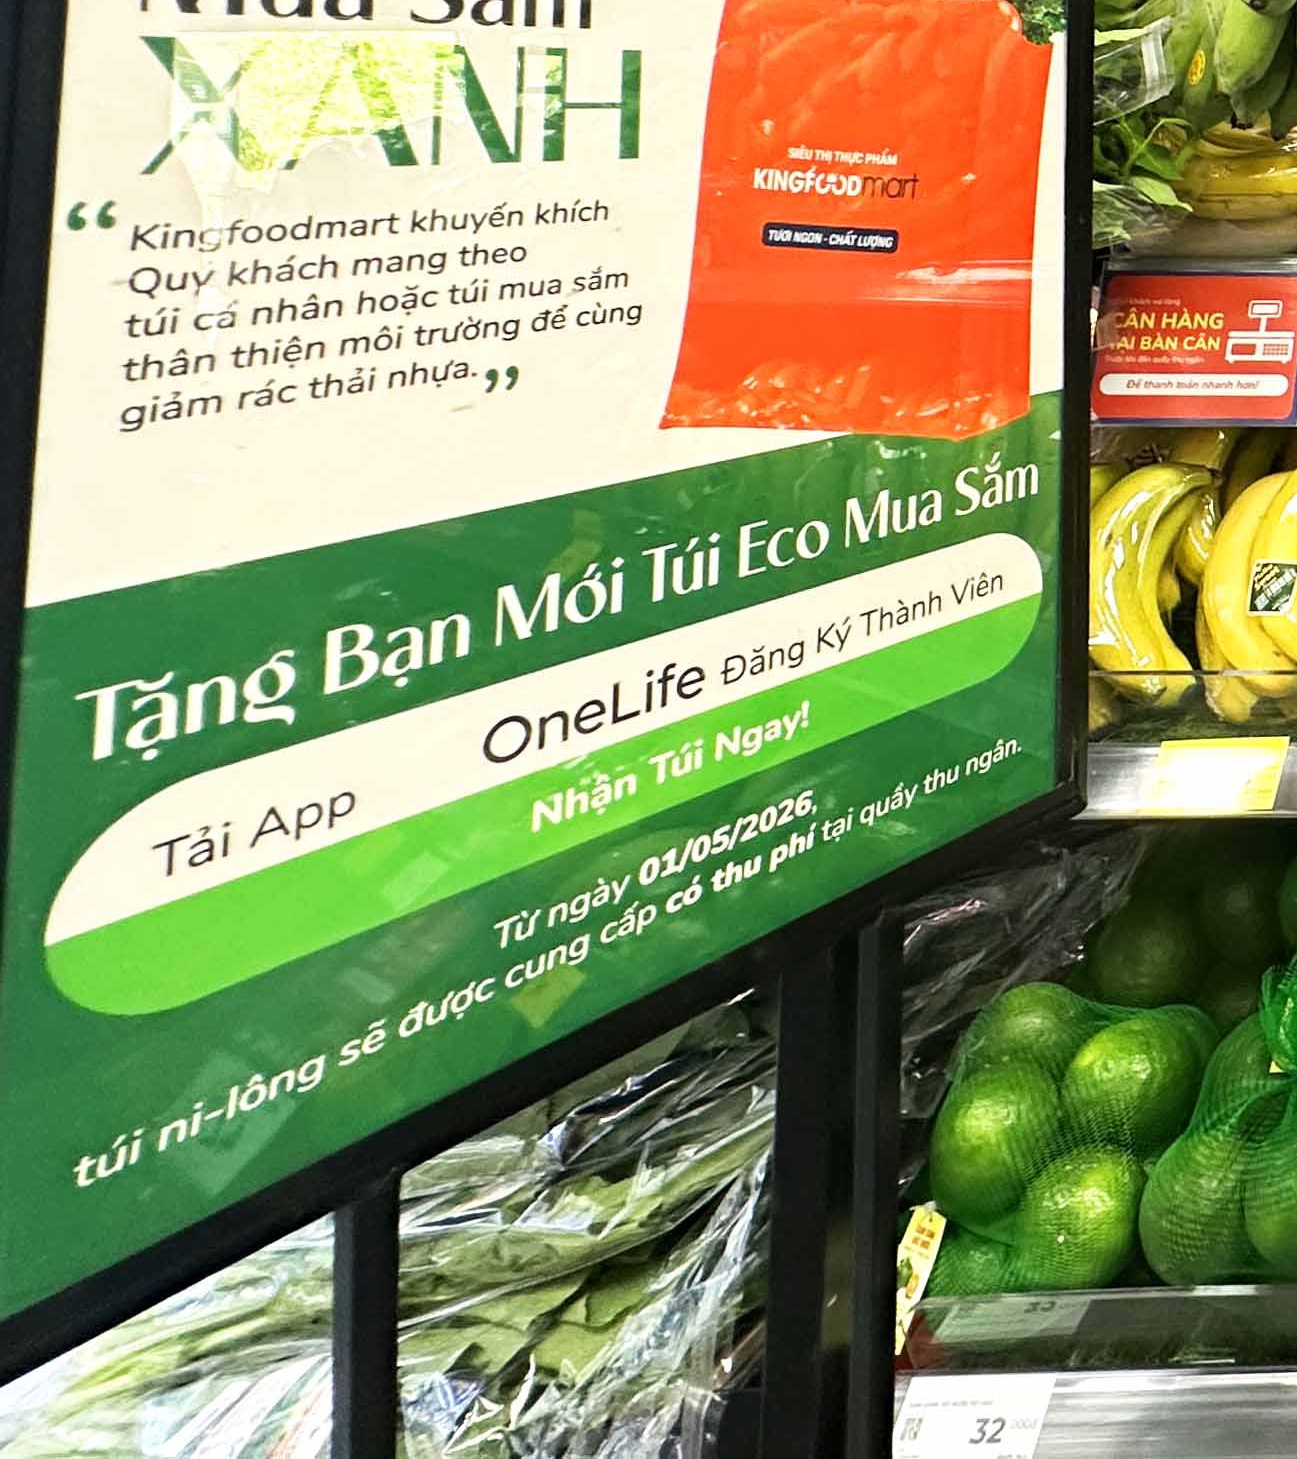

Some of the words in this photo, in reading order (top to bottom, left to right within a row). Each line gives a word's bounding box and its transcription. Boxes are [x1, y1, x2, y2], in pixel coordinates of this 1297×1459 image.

[130, 212, 400, 253] Kingfoodmart
[410, 204, 524, 235] khuyến
[536, 199, 609, 226] khích
[793, 231, 823, 244] NGON
[227, 252, 340, 287] khách
[352, 249, 447, 278] mang
[458, 242, 528, 268] theo
[124, 306, 182, 339] túi
[251, 292, 345, 327] nhân
[356, 285, 439, 317] hoặc
[449, 276, 489, 305] túi
[499, 277, 563, 301] mua
[572, 266, 630, 293] sắm
[1161, 307, 1224, 329] HÀNG
[122, 350, 218, 383] thân
[231, 335, 326, 371] thiện
[340, 326, 403, 357] môi
[415, 316, 521, 349] trường
[531, 303, 568, 334] để
[576, 300, 643, 331] cùng
[1140, 332, 1178, 351] BÀN
[1183, 333, 1220, 351] CÂN
[120, 394, 224, 432] giảm
[237, 378, 298, 409] rác
[309, 366, 377, 401] thải
[1144, 379, 1174, 389] thanh
[1201, 379, 1233, 389] nhanh
[76, 648, 297, 761] Tặng
[323, 612, 471, 694] Bạn
[496, 557, 625, 647] Mới
[642, 532, 721, 602] Túi
[738, 519, 829, 579] Eco
[844, 490, 944, 549] Mua
[955, 452, 1040, 517] Sắm
[152, 820, 233, 876] Tải
[250, 790, 357, 849] App
[482, 662, 706, 764] OneLife
[721, 640, 805, 686] Đăng
[815, 615, 854, 654] Ký
[860, 592, 944, 639] Thành
[950, 570, 1004, 607] Viên
[530, 770, 638, 833] Nhận
[649, 739, 703, 787] Túi
[714, 700, 811, 763] Ngay!
[493, 908, 541, 951] Từ
[546, 874, 632, 929] ngày
[74, 1127, 142, 1189] túi
[157, 1054, 325, 1152] ni-lông
[338, 1020, 386, 1067] sẽ
[398, 978, 495, 1038] được
[505, 933, 591, 989] cung
[600, 895, 656, 945] cấp
[666, 876, 703, 913] có
[711, 856, 761, 893] thu
[769, 825, 817, 875] phí
[823, 807, 853, 844] tại
[859, 782, 918, 826] quầy
[923, 765, 960, 794] thu
[965, 738, 1022, 776] ngân.
[968, 1418, 1006, 1444] 32
